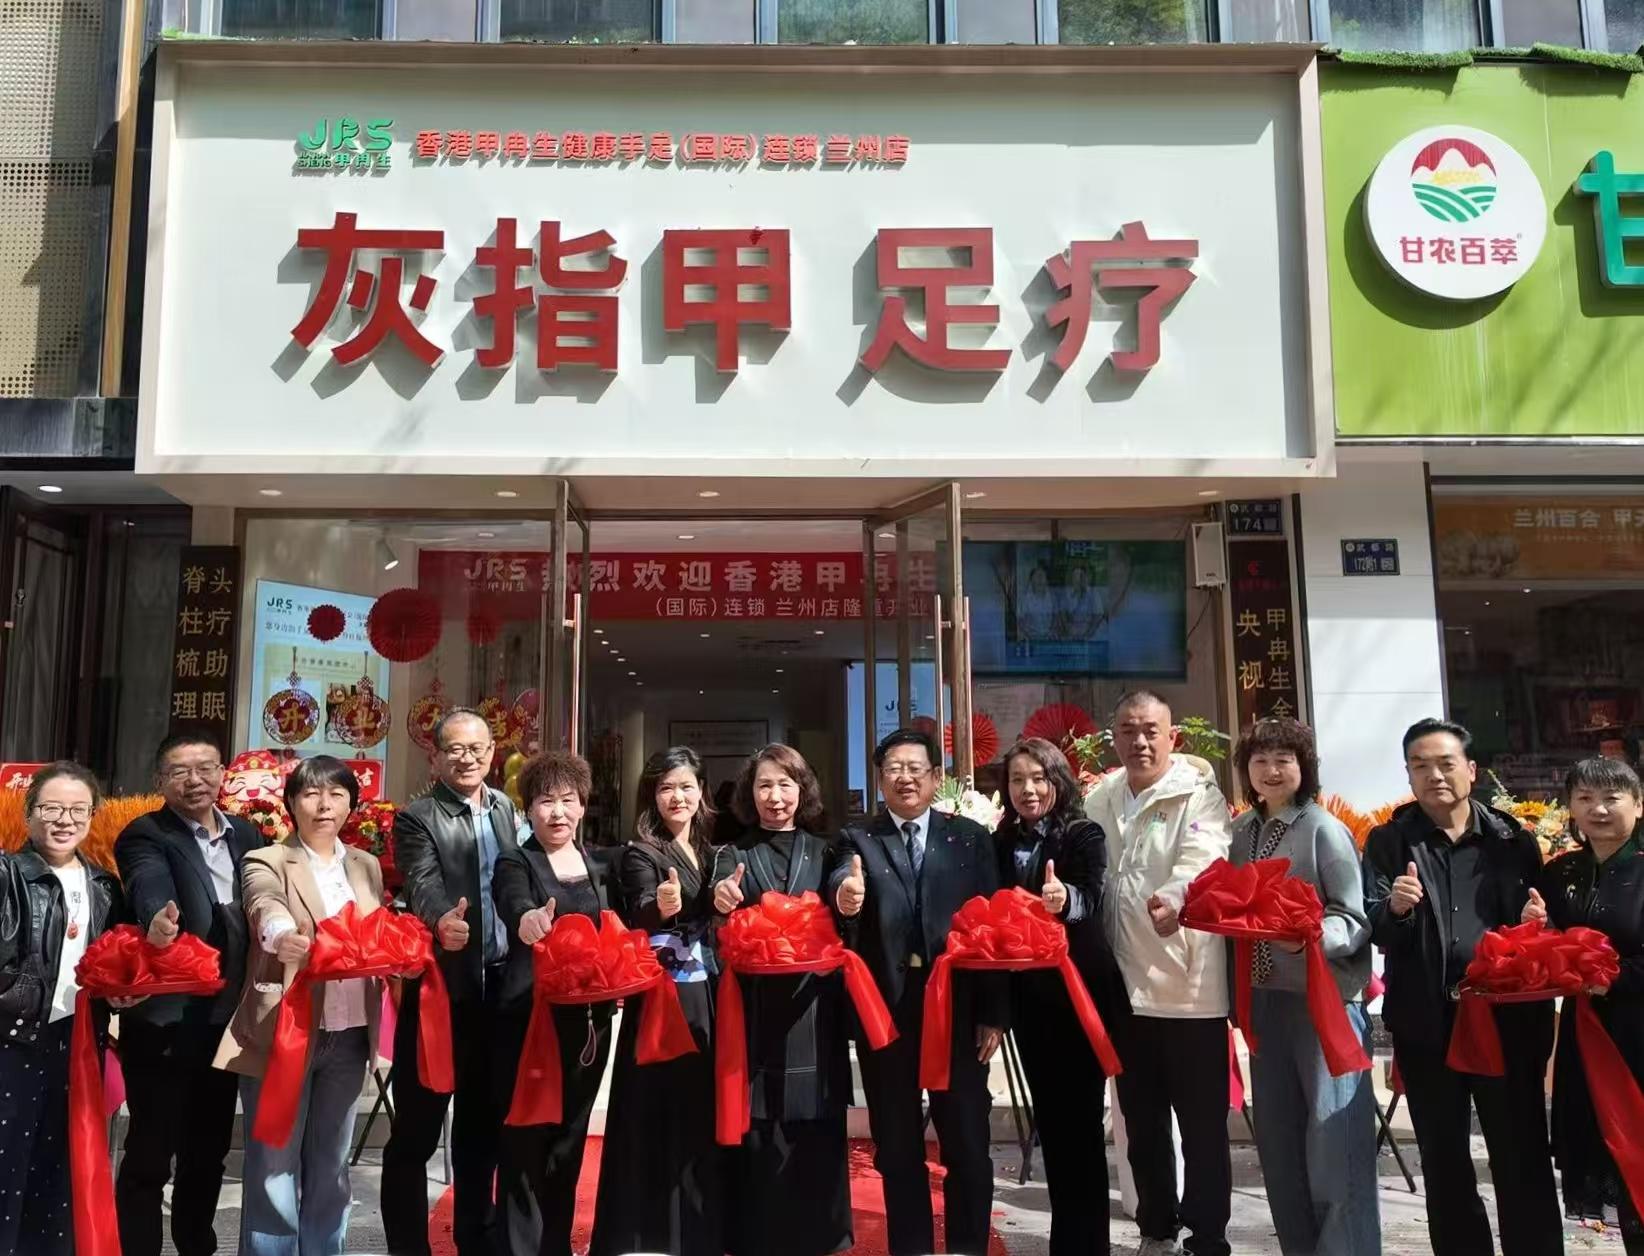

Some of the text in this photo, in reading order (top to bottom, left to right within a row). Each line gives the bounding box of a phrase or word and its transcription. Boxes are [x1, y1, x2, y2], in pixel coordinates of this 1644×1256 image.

[298, 118, 394, 150] JRS
[1399, 236, 1519, 265] 甘农百萃
[464, 558, 528, 580] JRS
[267, 597, 293, 609] JRS
[172, 565, 206, 720] 脊柱梳理
[201, 567, 233, 721] 头疗助眠
